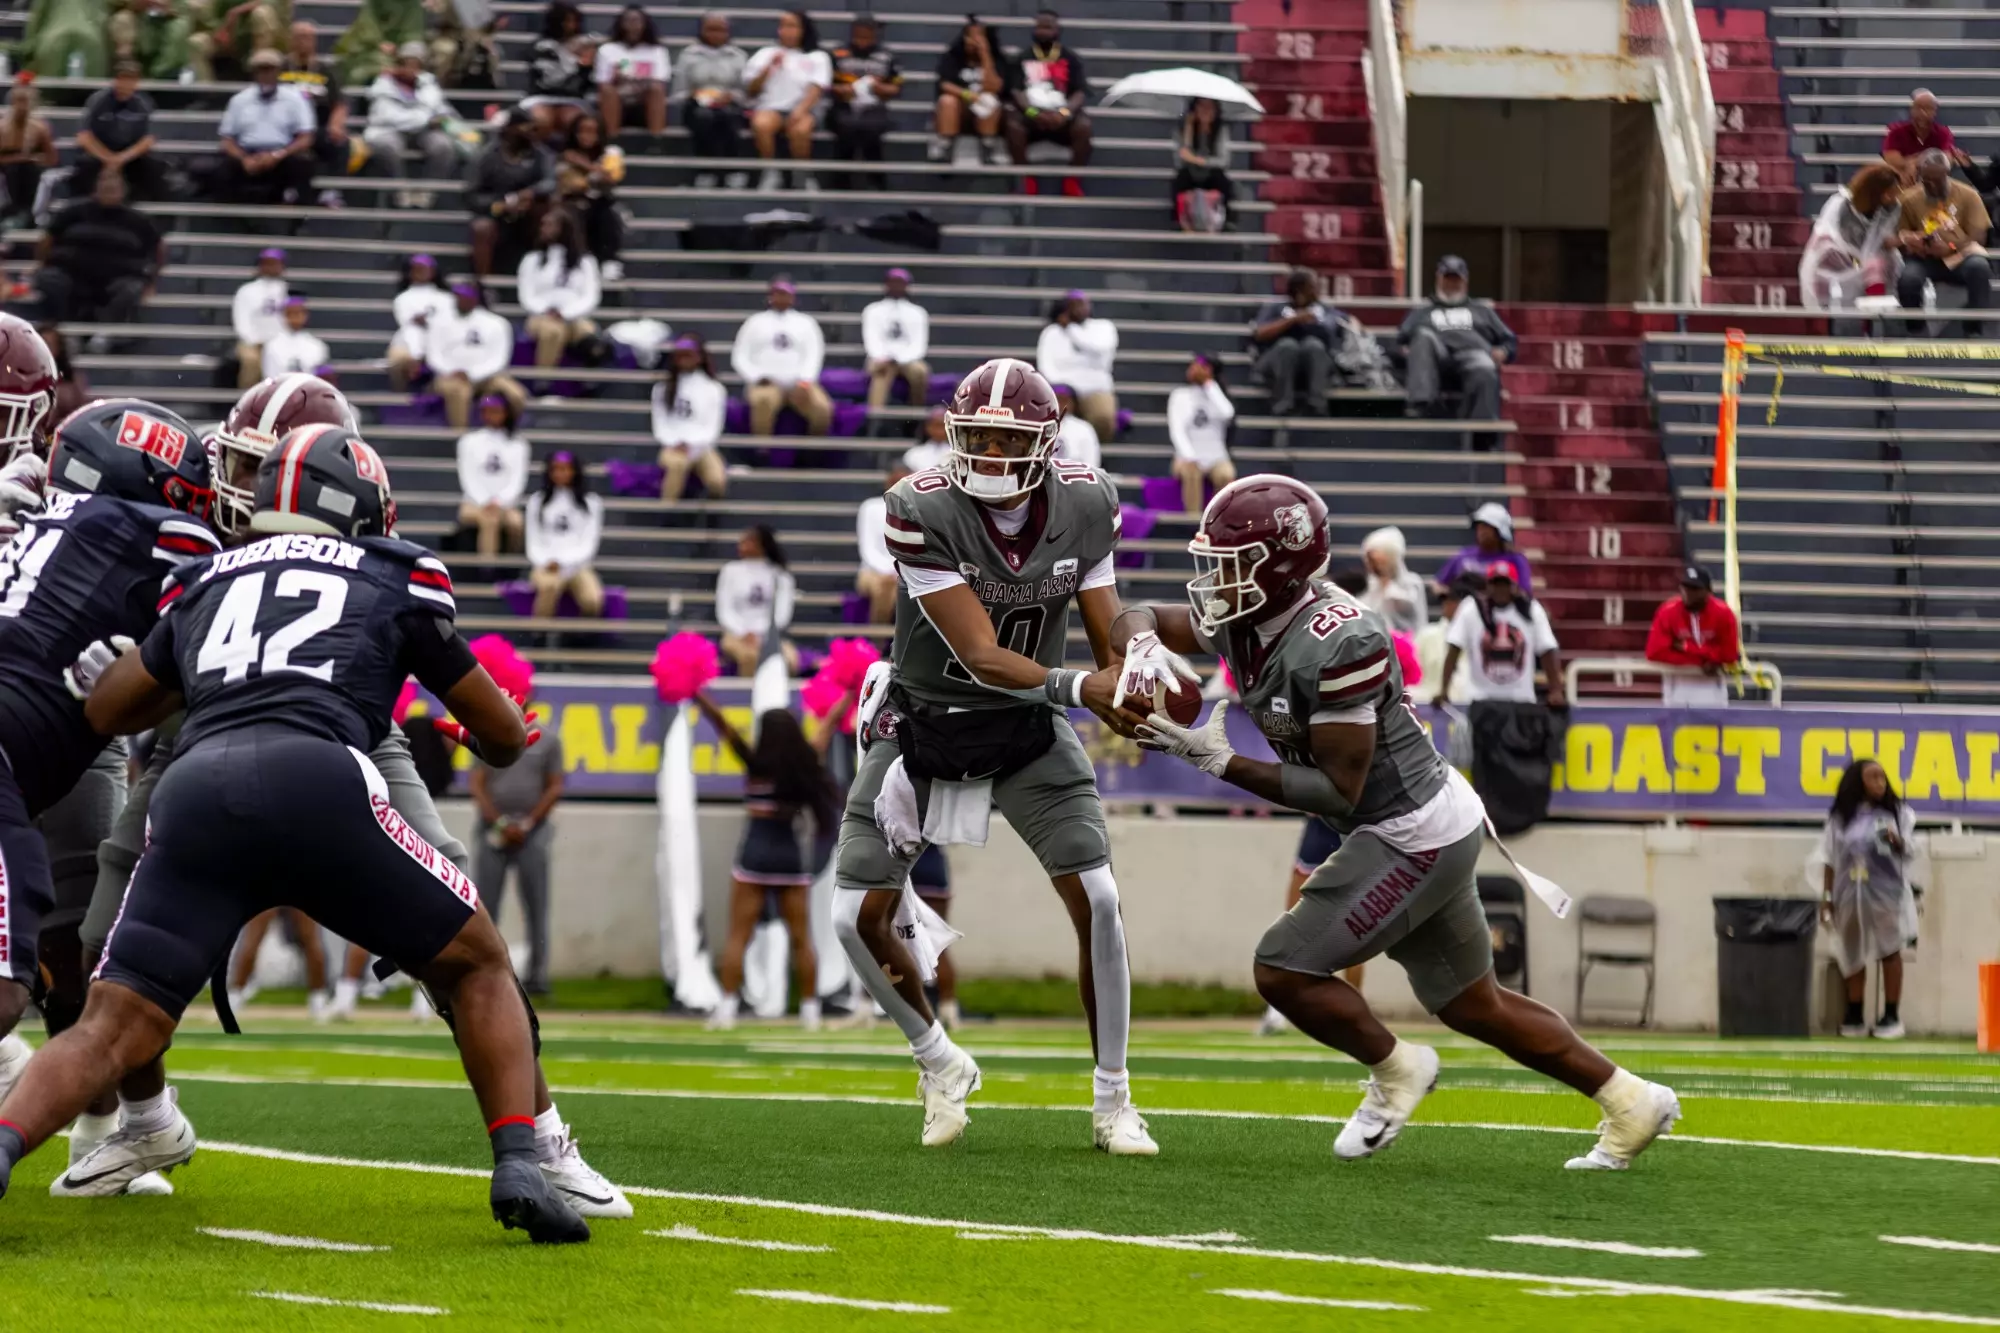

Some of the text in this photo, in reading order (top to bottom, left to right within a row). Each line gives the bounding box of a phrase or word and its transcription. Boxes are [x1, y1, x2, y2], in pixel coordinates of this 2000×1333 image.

[1292, 152, 1331, 178] 22
[1721, 160, 1760, 189] 22
[1302, 212, 1341, 239] 20
[980, 407, 1010, 417] Riddell
[1558, 400, 1594, 431] 14
[1574, 462, 1612, 495] 12
[200, 533, 366, 584] JOHNSON
[1588, 526, 1621, 560] 10
[966, 572, 1078, 603] ABAMA A&M
[196, 569, 349, 686] 42
[1308, 602, 1363, 641] 20
[1551, 723, 1781, 796] OAST
[371, 794, 479, 908] JACKSON STA
[1343, 865, 1422, 941] ALABAMA
